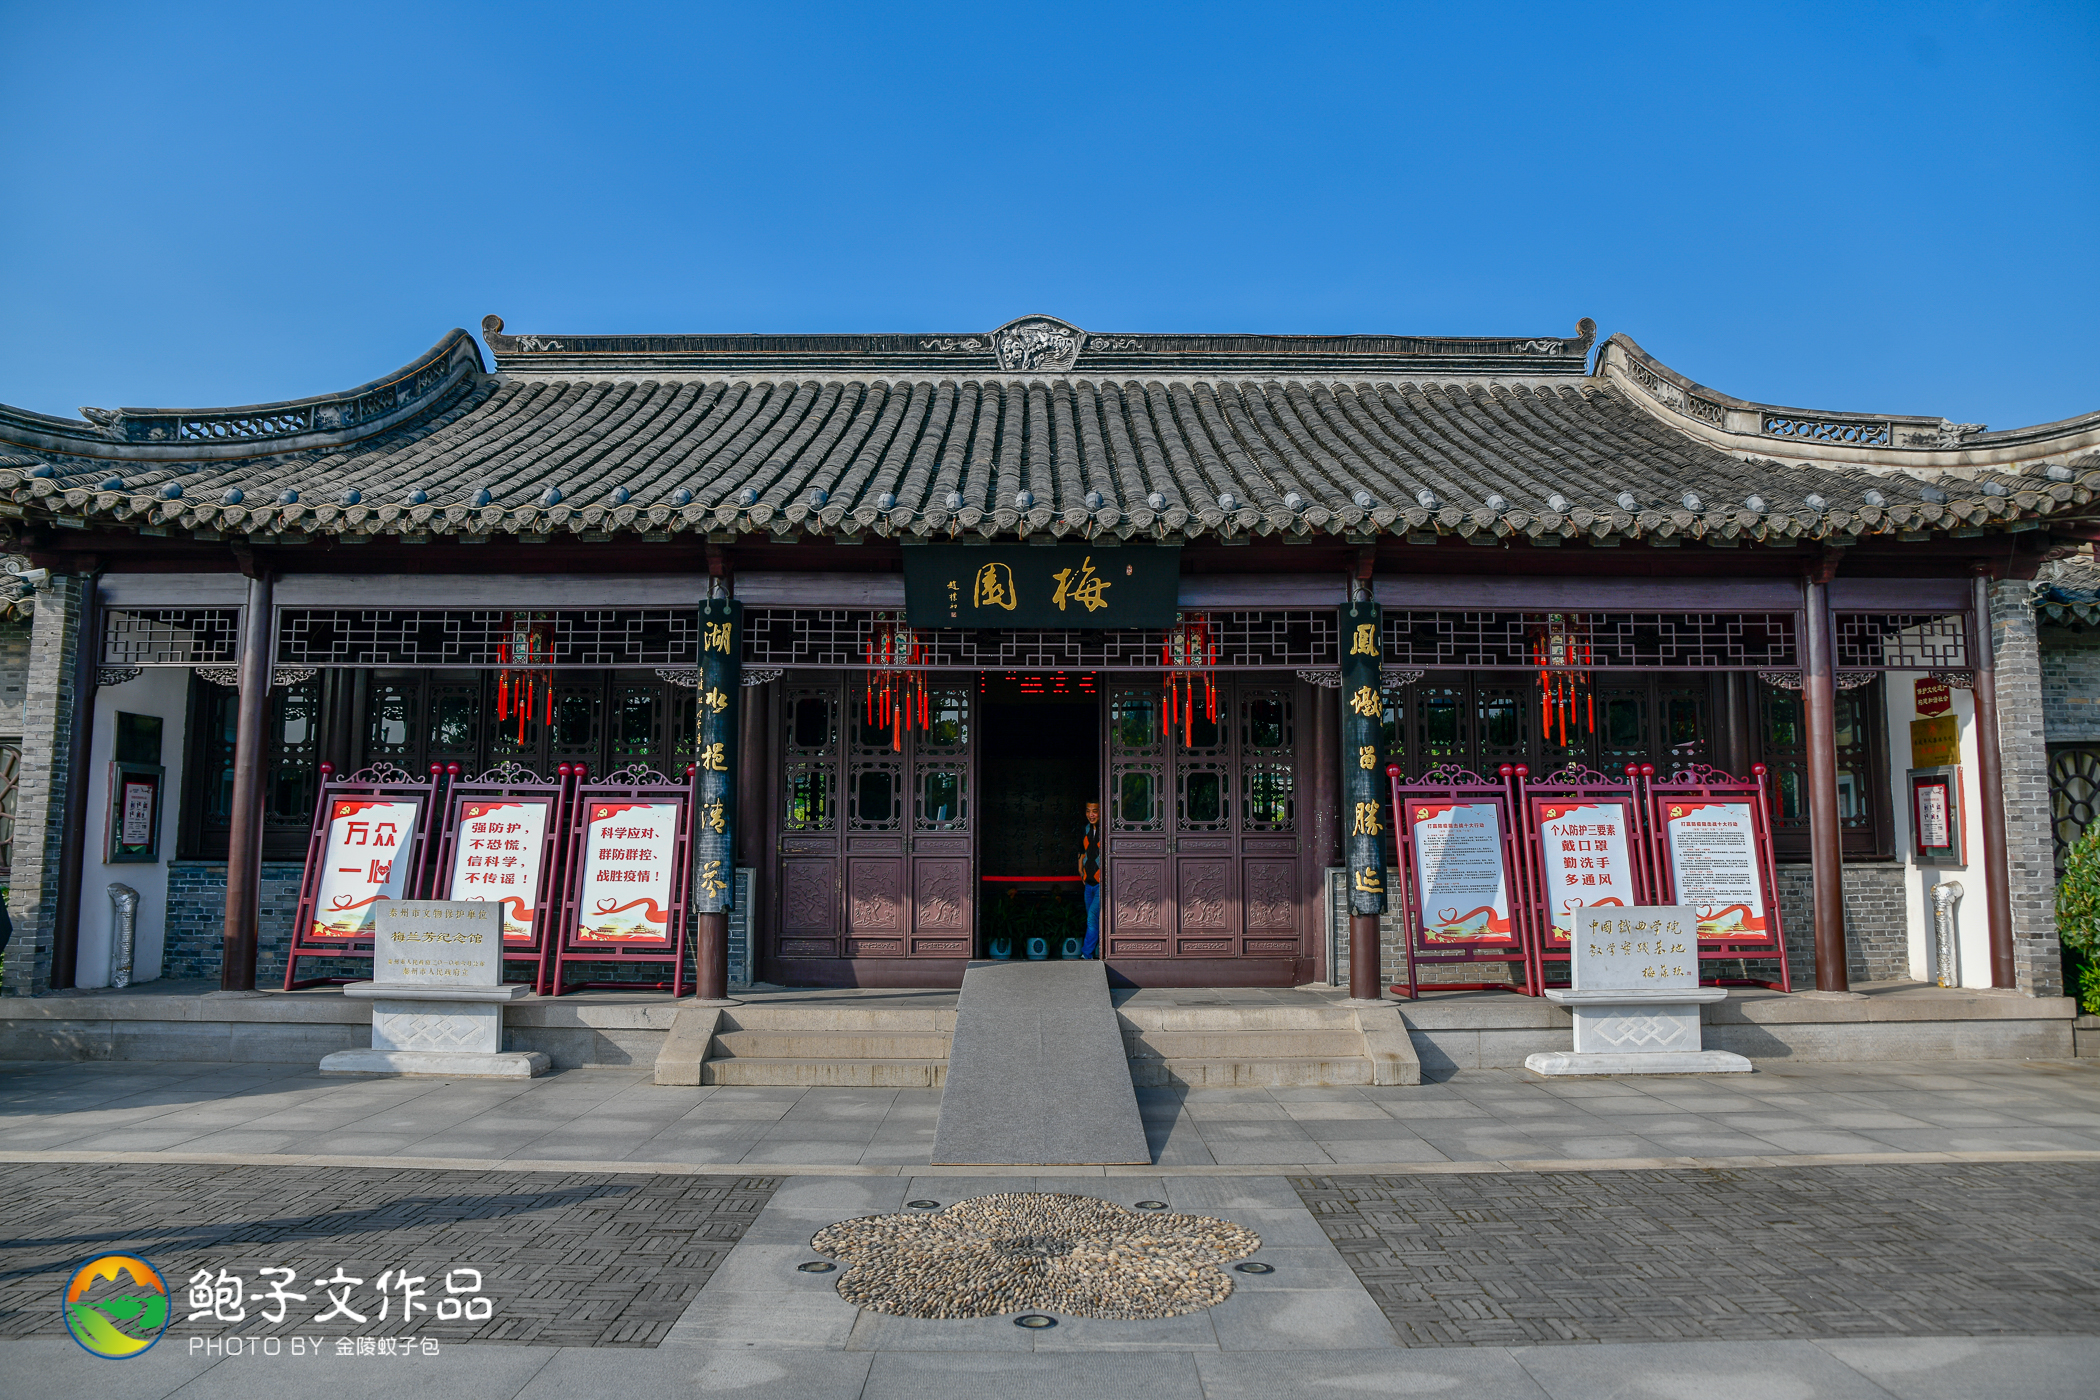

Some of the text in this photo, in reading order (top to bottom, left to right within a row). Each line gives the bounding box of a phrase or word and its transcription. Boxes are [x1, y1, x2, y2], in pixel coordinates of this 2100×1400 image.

[344, 821, 397, 846] 万众
[600, 827, 660, 840] 科学应对、
[1550, 824, 1616, 836] 个人防护三要素
[1562, 840, 1608, 852] 戴口罩
[598, 848, 658, 860] 群防群控、
[1563, 856, 1610, 869] 勤洗手
[338, 859, 392, 884] 一心
[596, 870, 660, 882] 战胜疫情！
[1565, 874, 1612, 886] 多通风
[388, 908, 488, 920] 泰州市文物保护单位
[391, 932, 484, 944] 梅兰芳纪念馆
[402, 968, 469, 977] 泰州市人民政府立
[1642, 964, 1685, 978] 梅葆玖
